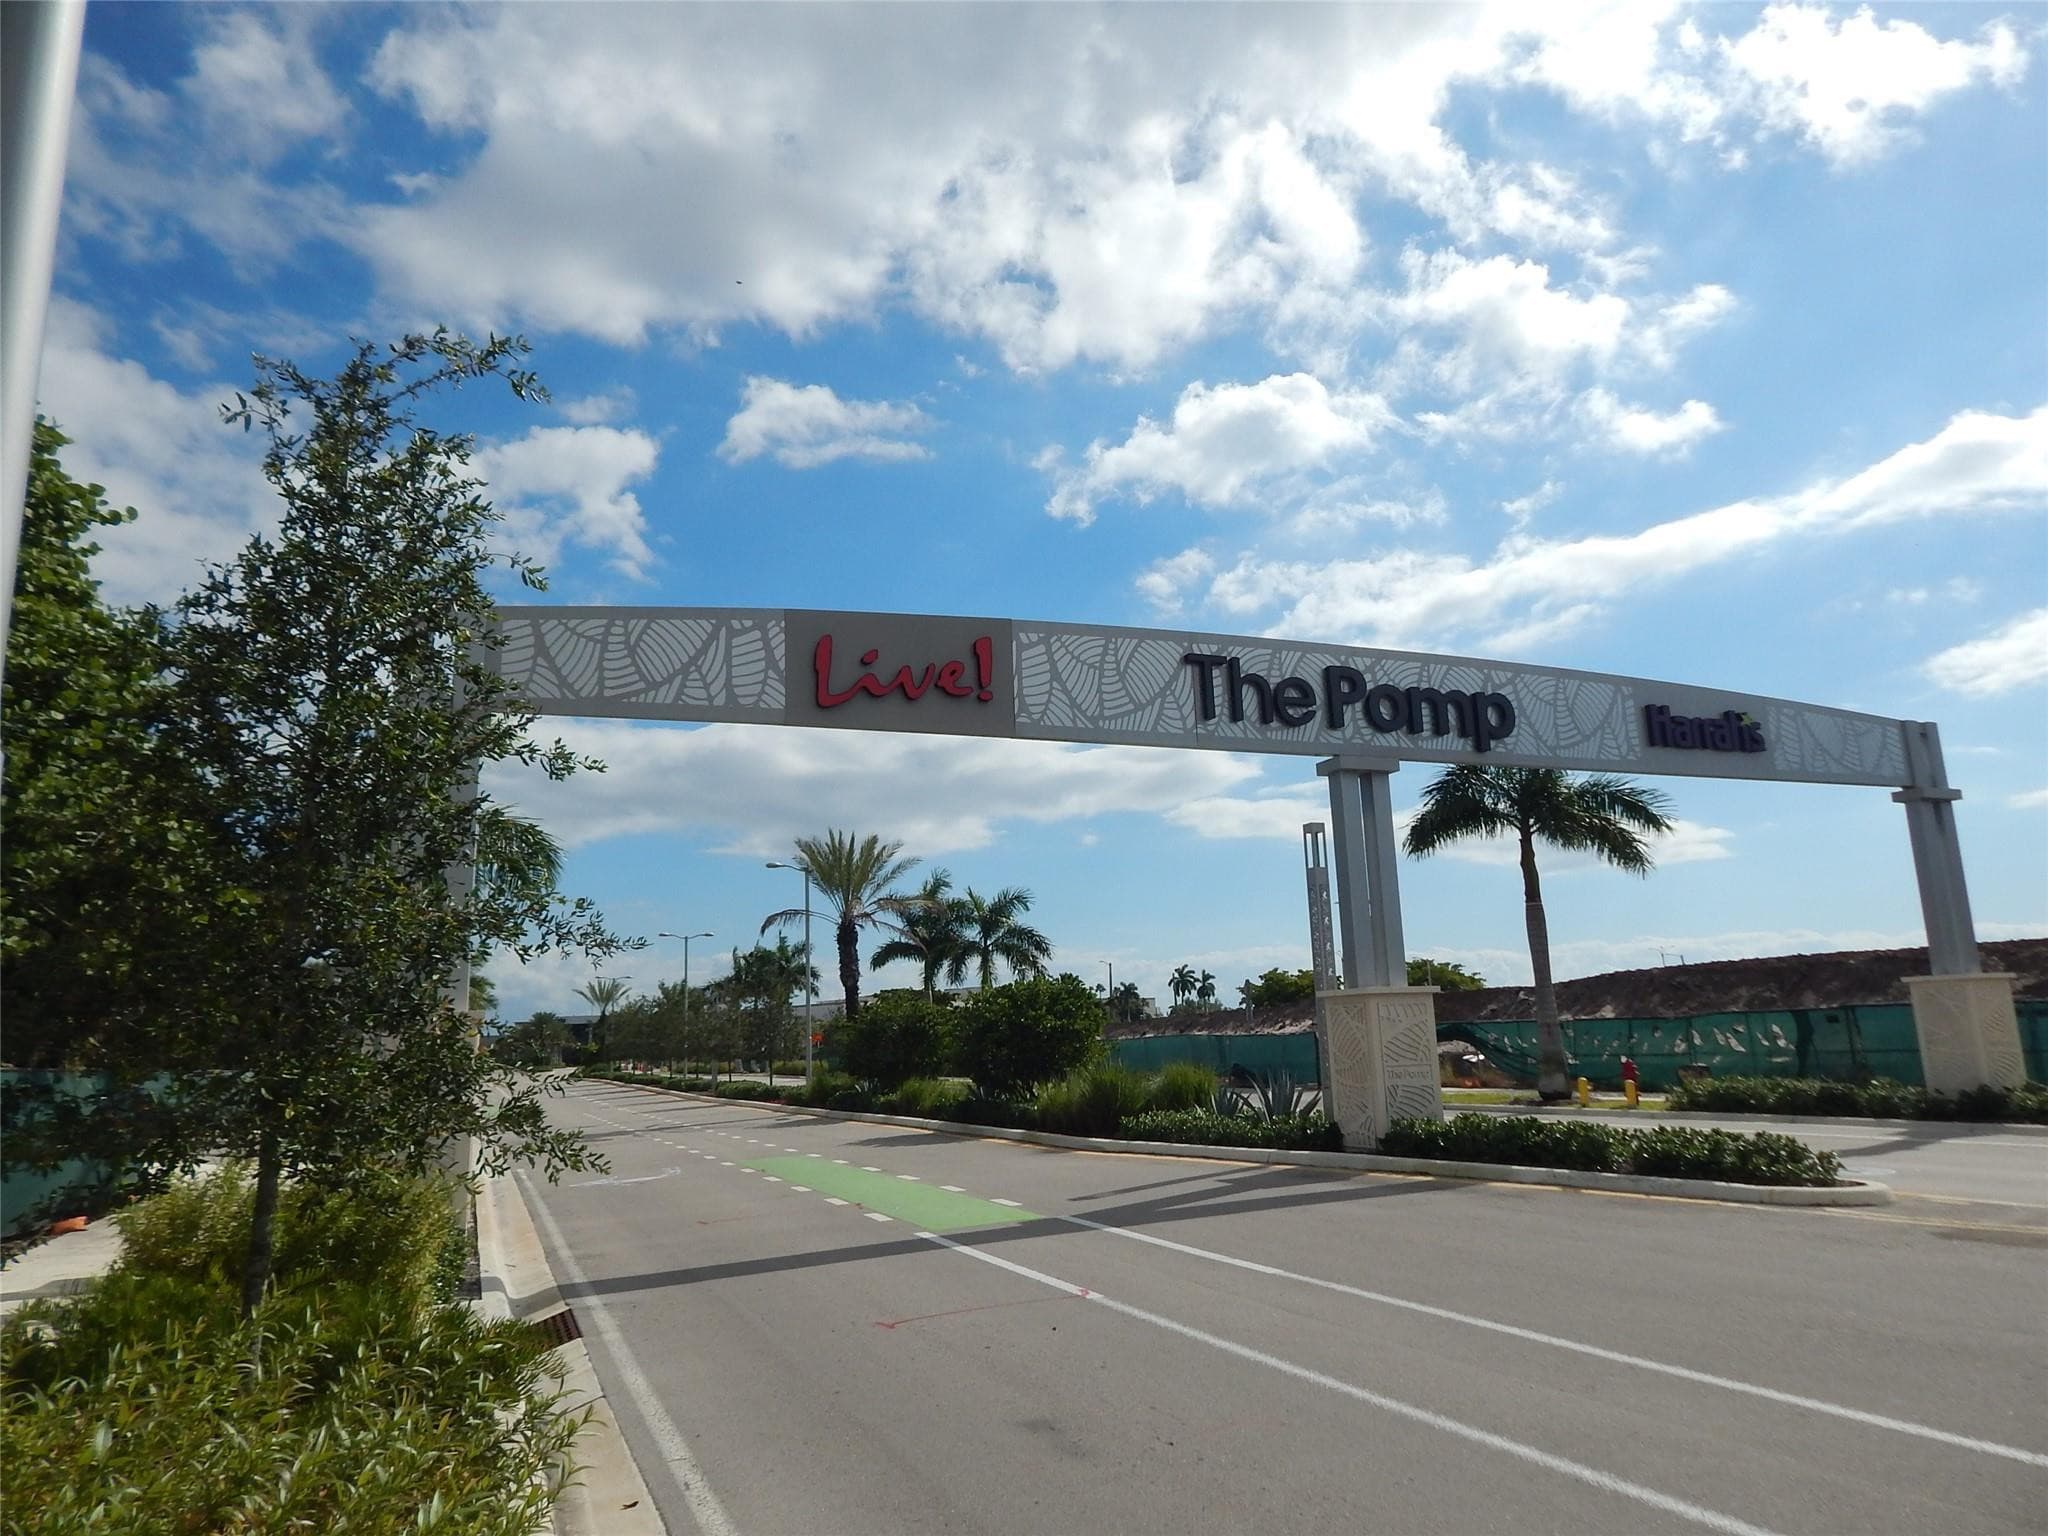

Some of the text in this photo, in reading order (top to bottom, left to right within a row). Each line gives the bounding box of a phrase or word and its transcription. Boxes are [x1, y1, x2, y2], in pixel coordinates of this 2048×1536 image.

[814, 634, 993, 709] Live!
[1184, 653, 1516, 753] The Pomp
